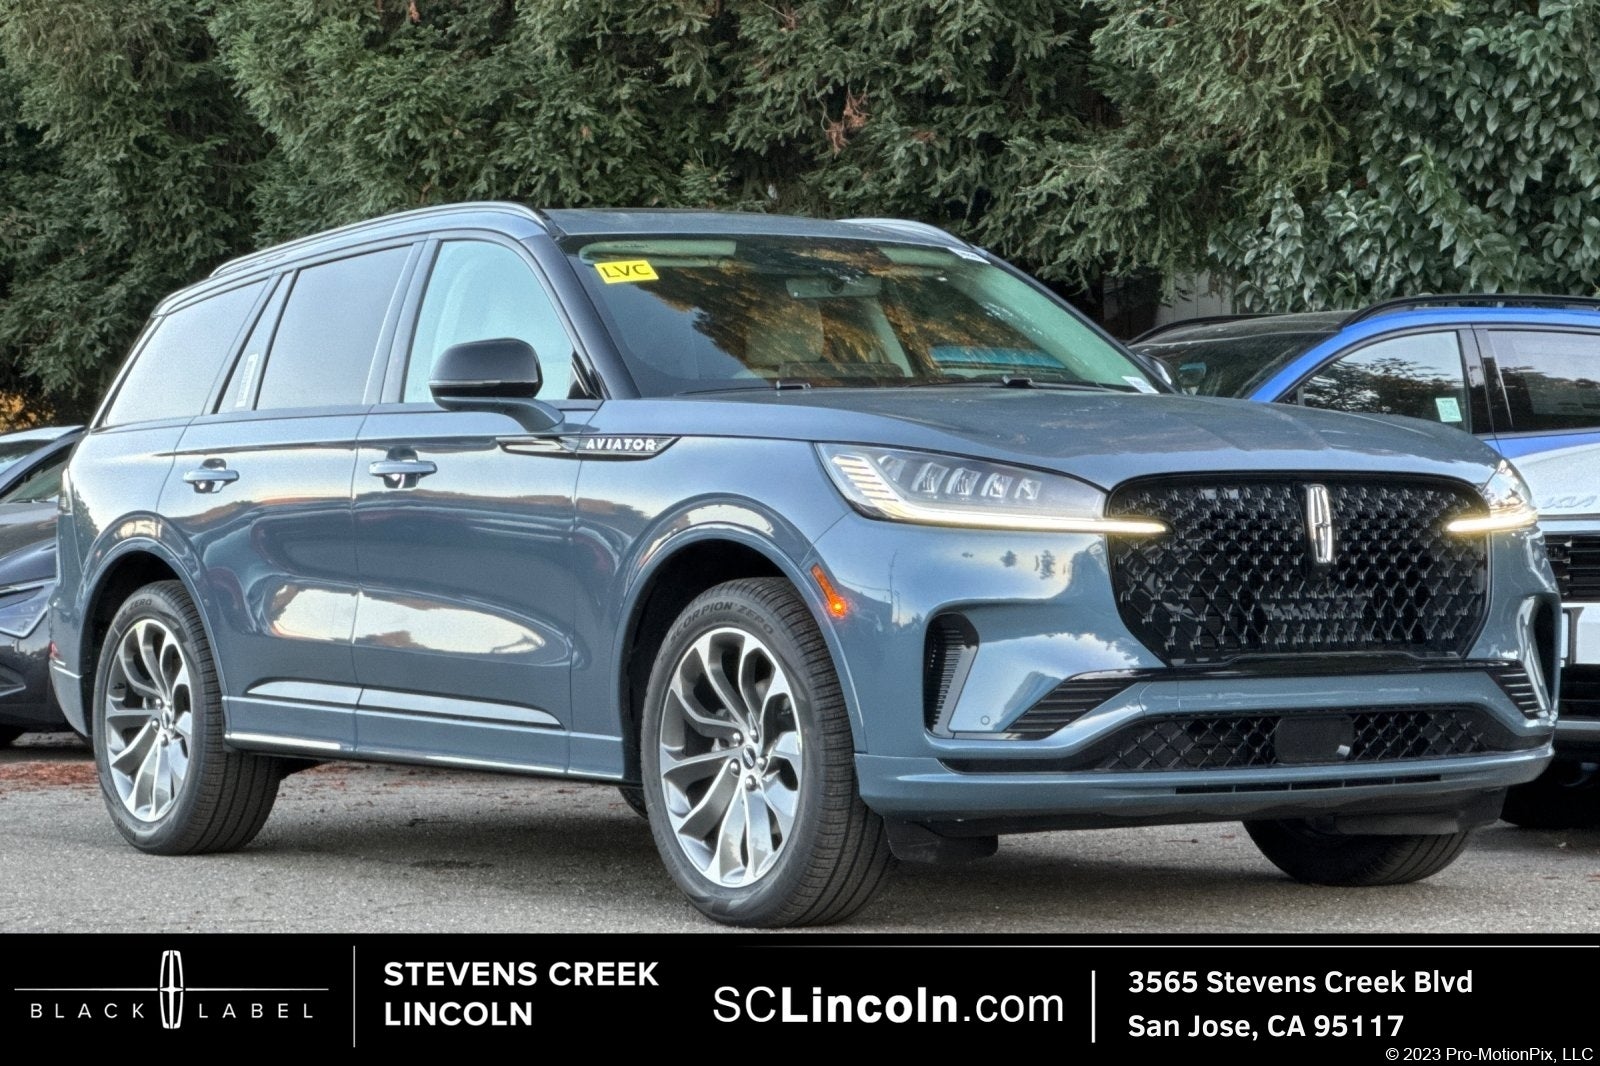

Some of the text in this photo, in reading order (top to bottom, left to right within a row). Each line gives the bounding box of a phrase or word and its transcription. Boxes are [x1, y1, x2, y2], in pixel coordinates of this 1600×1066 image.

[602, 264, 650, 278] LVC
[586, 438, 656, 450] AVIATOR
[736, 604, 774, 634] ZERO
